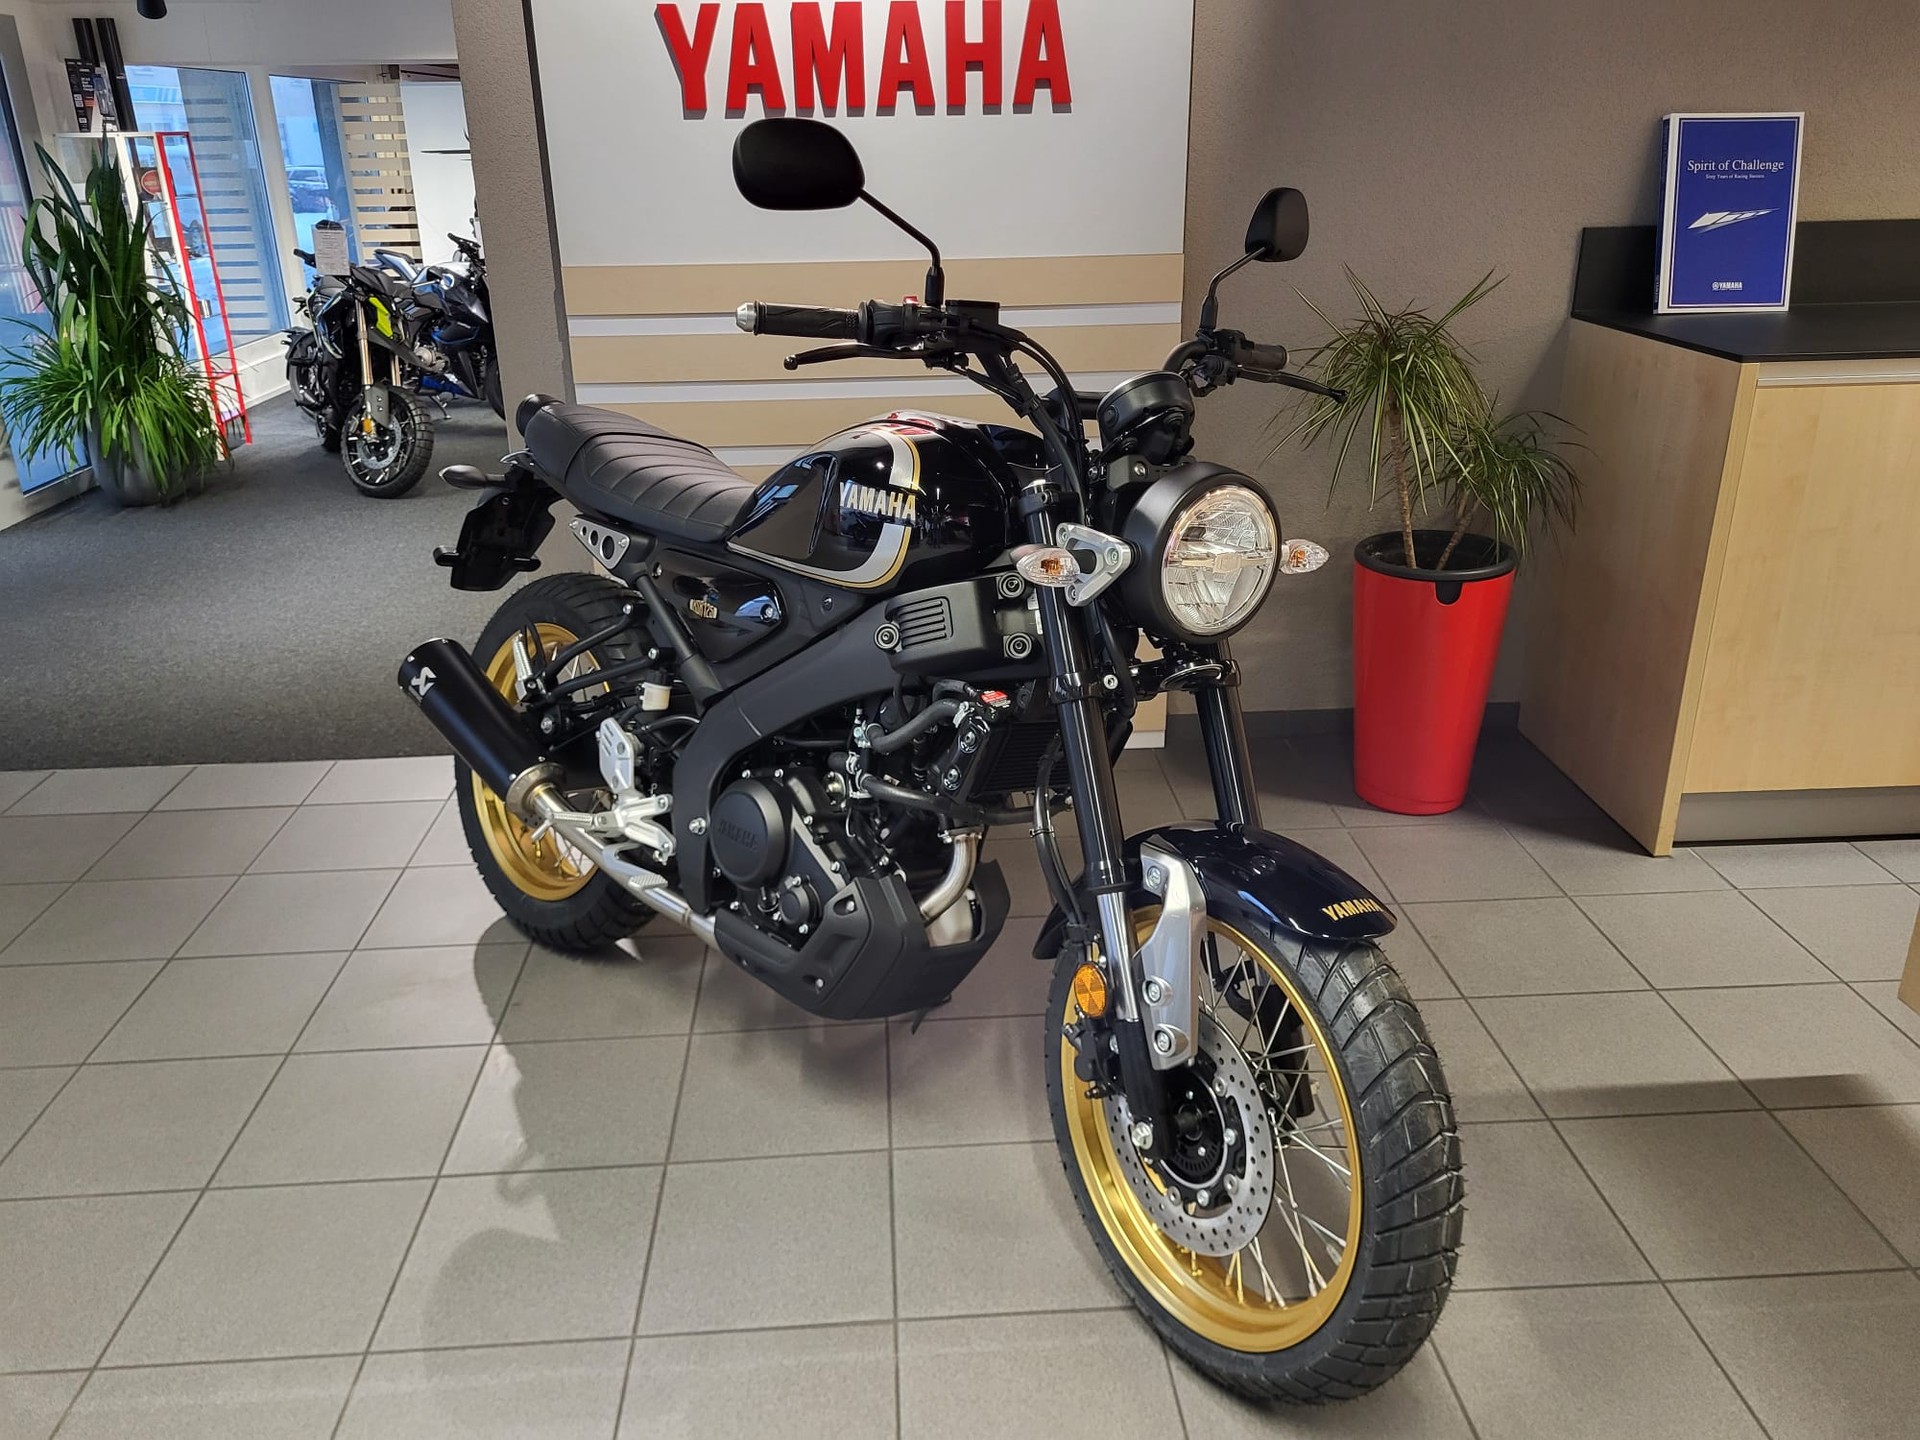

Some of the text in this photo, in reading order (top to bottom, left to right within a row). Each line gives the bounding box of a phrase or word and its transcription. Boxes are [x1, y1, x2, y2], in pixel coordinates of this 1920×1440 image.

[655, 0, 1072, 118] YAMAHA
[1687, 159, 1785, 174] Spirit of Challenge
[1720, 281, 1743, 290] YAMAHA
[840, 481, 916, 522] YAMAHA
[1321, 898, 1384, 921] YAMAHA
